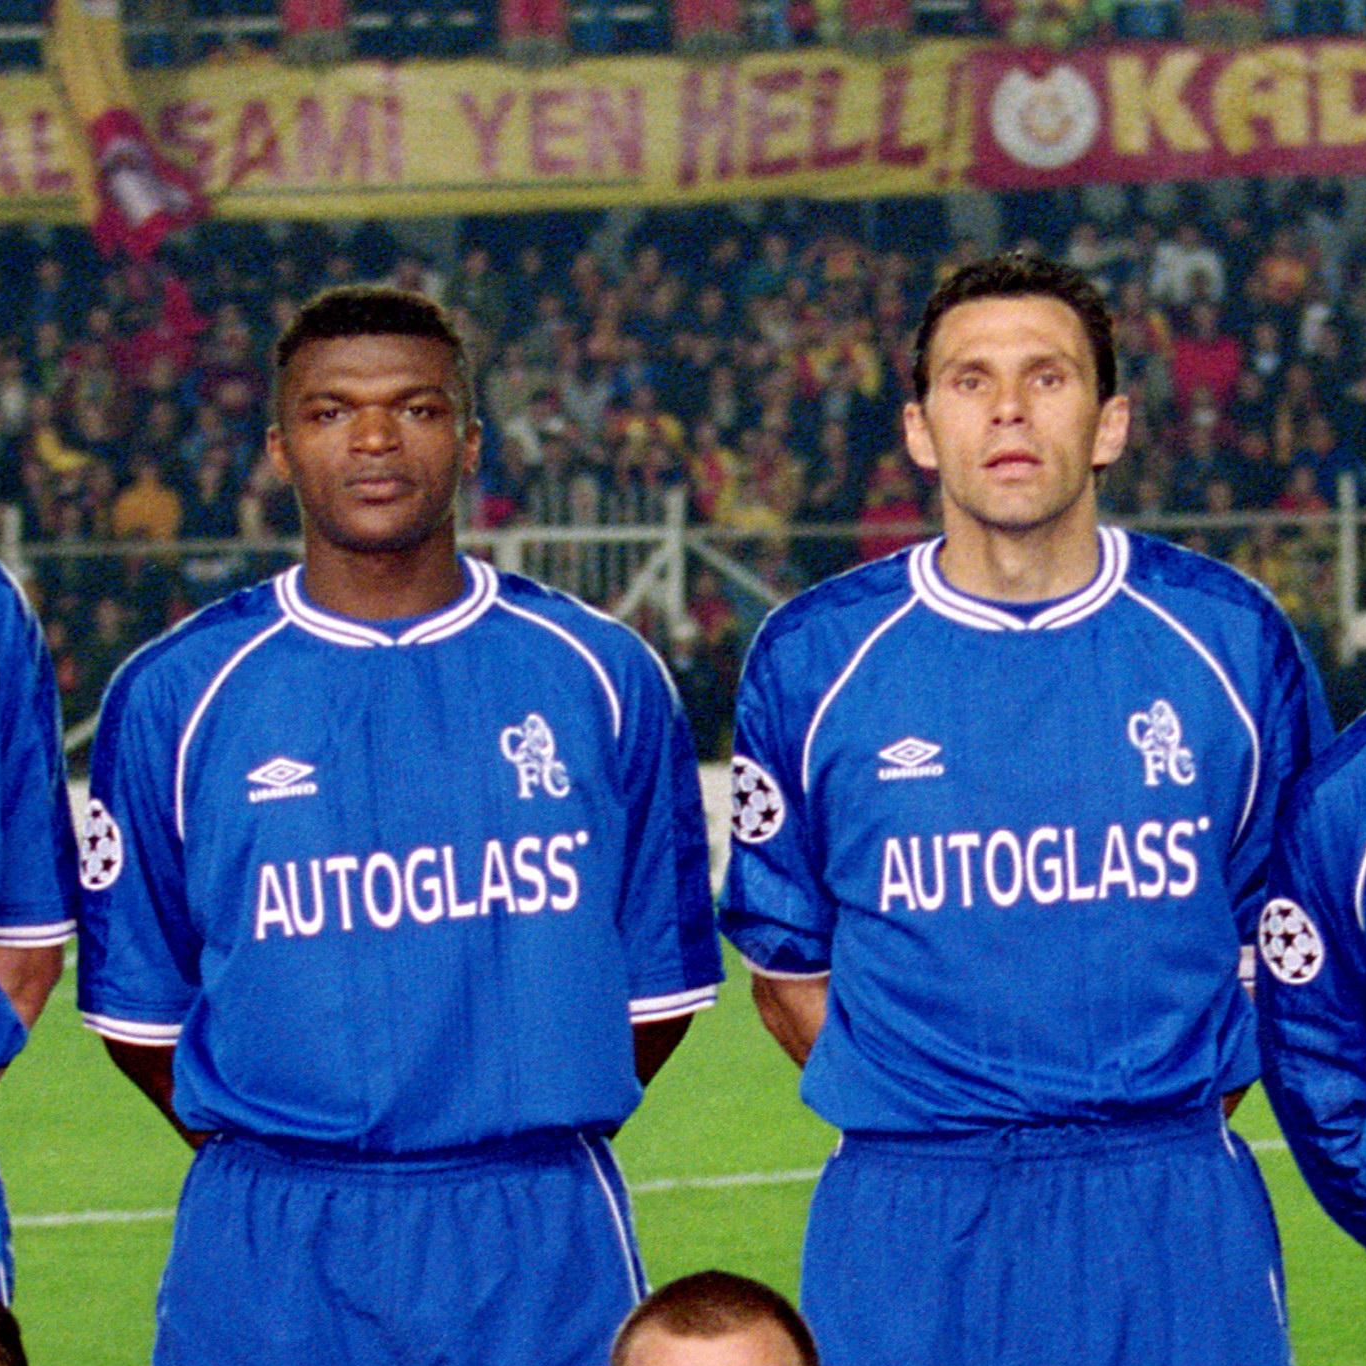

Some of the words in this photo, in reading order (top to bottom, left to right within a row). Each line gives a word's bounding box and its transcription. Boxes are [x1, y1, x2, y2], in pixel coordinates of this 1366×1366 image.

[457, 86, 646, 177] YEN
[254, 834, 580, 940] AUTOGLASS
[880, 821, 1199, 912] AUTOGLASS
